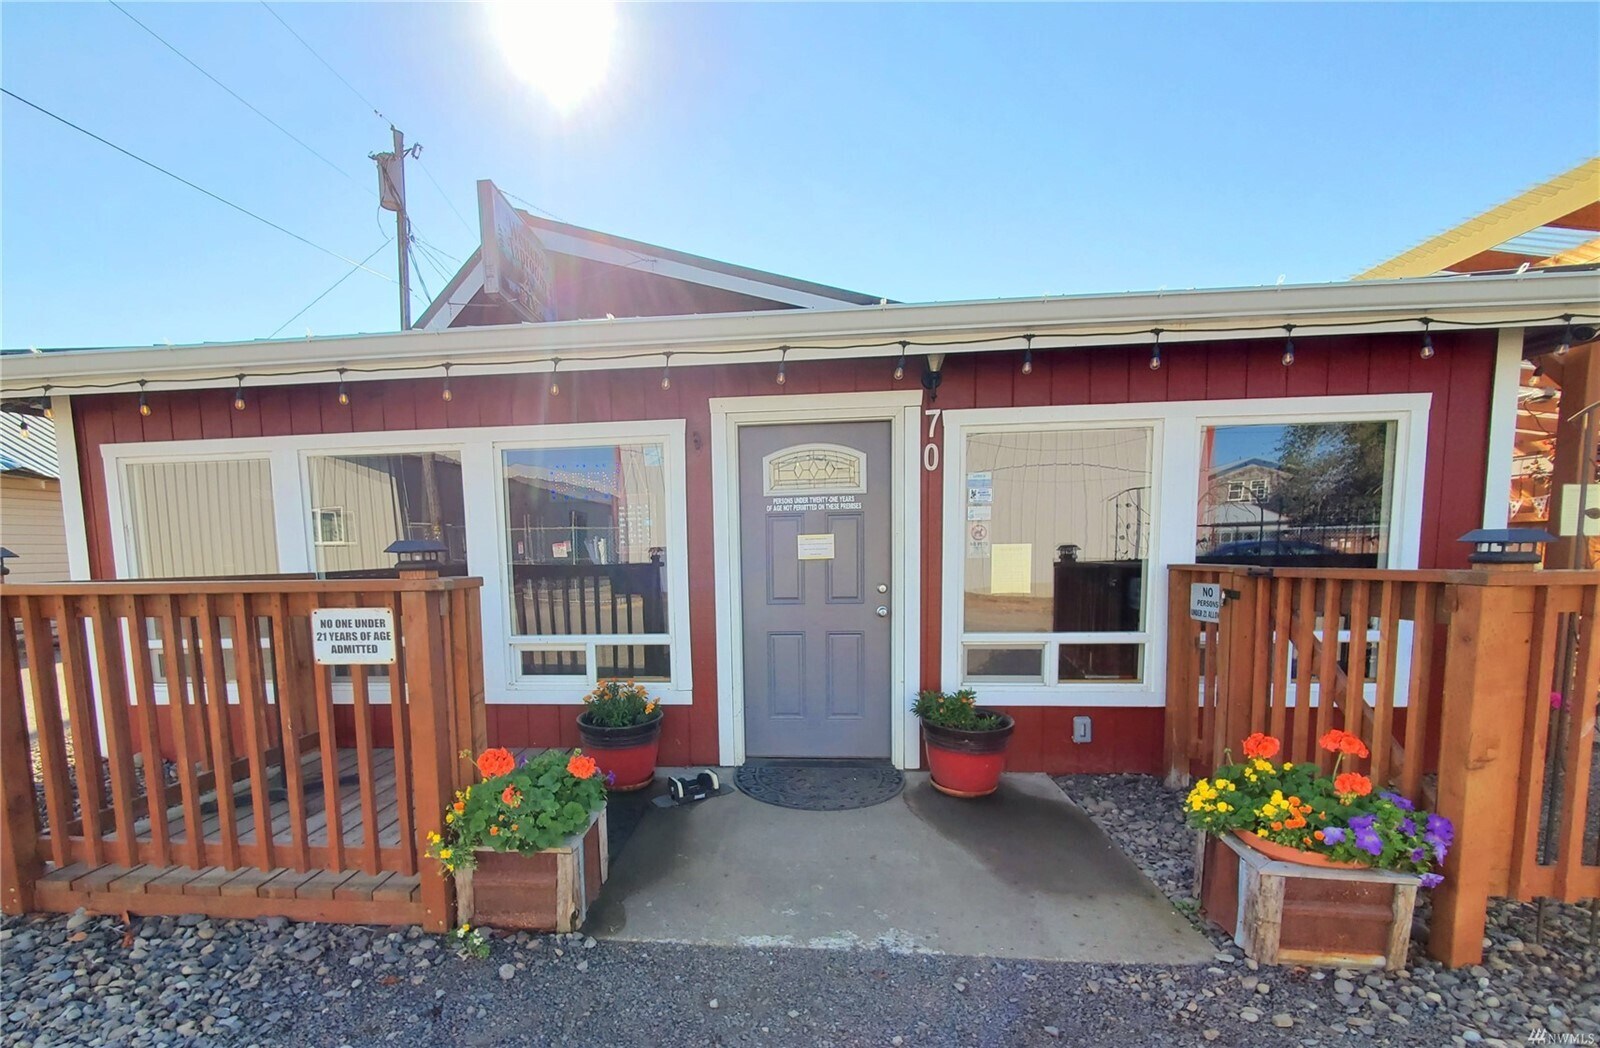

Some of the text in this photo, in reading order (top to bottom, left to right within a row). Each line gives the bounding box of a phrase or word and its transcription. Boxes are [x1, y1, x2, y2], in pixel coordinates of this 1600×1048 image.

[772, 495, 855, 505] PERSONS UNDER TWENTY-ONE YEARS
[773, 504, 782, 512] AGE
[783, 504, 792, 512] NOT
[793, 503, 817, 511] PERMITTED
[818, 503, 825, 511] ON
[840, 502, 862, 510] PREMISES
[1202, 587, 1214, 598] NO
[1197, 599, 1219, 609] PERSONS
[320, 618, 386, 629] NO ONE UNDER
[316, 631, 392, 642] 21 YEARS OF AGE
[331, 644, 378, 654] ADMITTED
